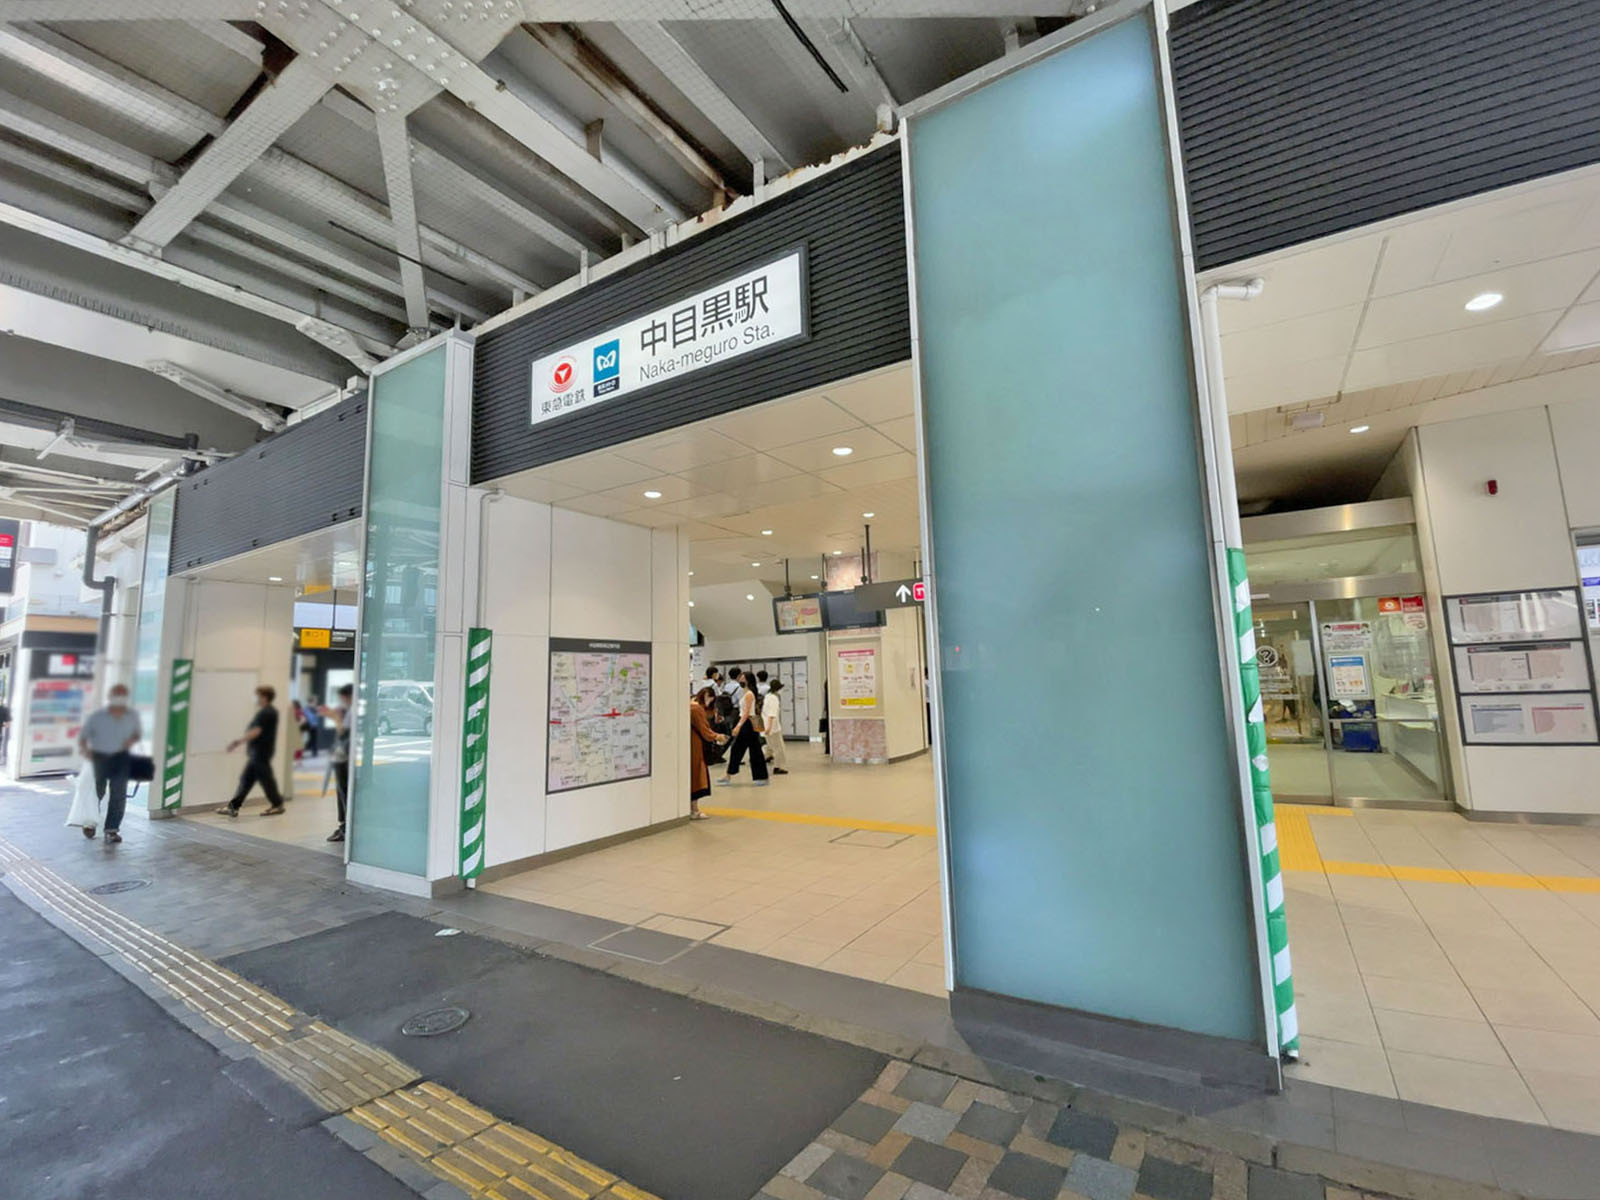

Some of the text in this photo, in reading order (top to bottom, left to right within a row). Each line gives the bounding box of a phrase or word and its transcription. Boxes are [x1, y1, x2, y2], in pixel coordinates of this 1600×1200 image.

[640, 276, 769, 356] 中目黒駅
[640, 325, 775, 382] Naka-meguro Sta.
[541, 389, 586, 414] 東急電鉄
